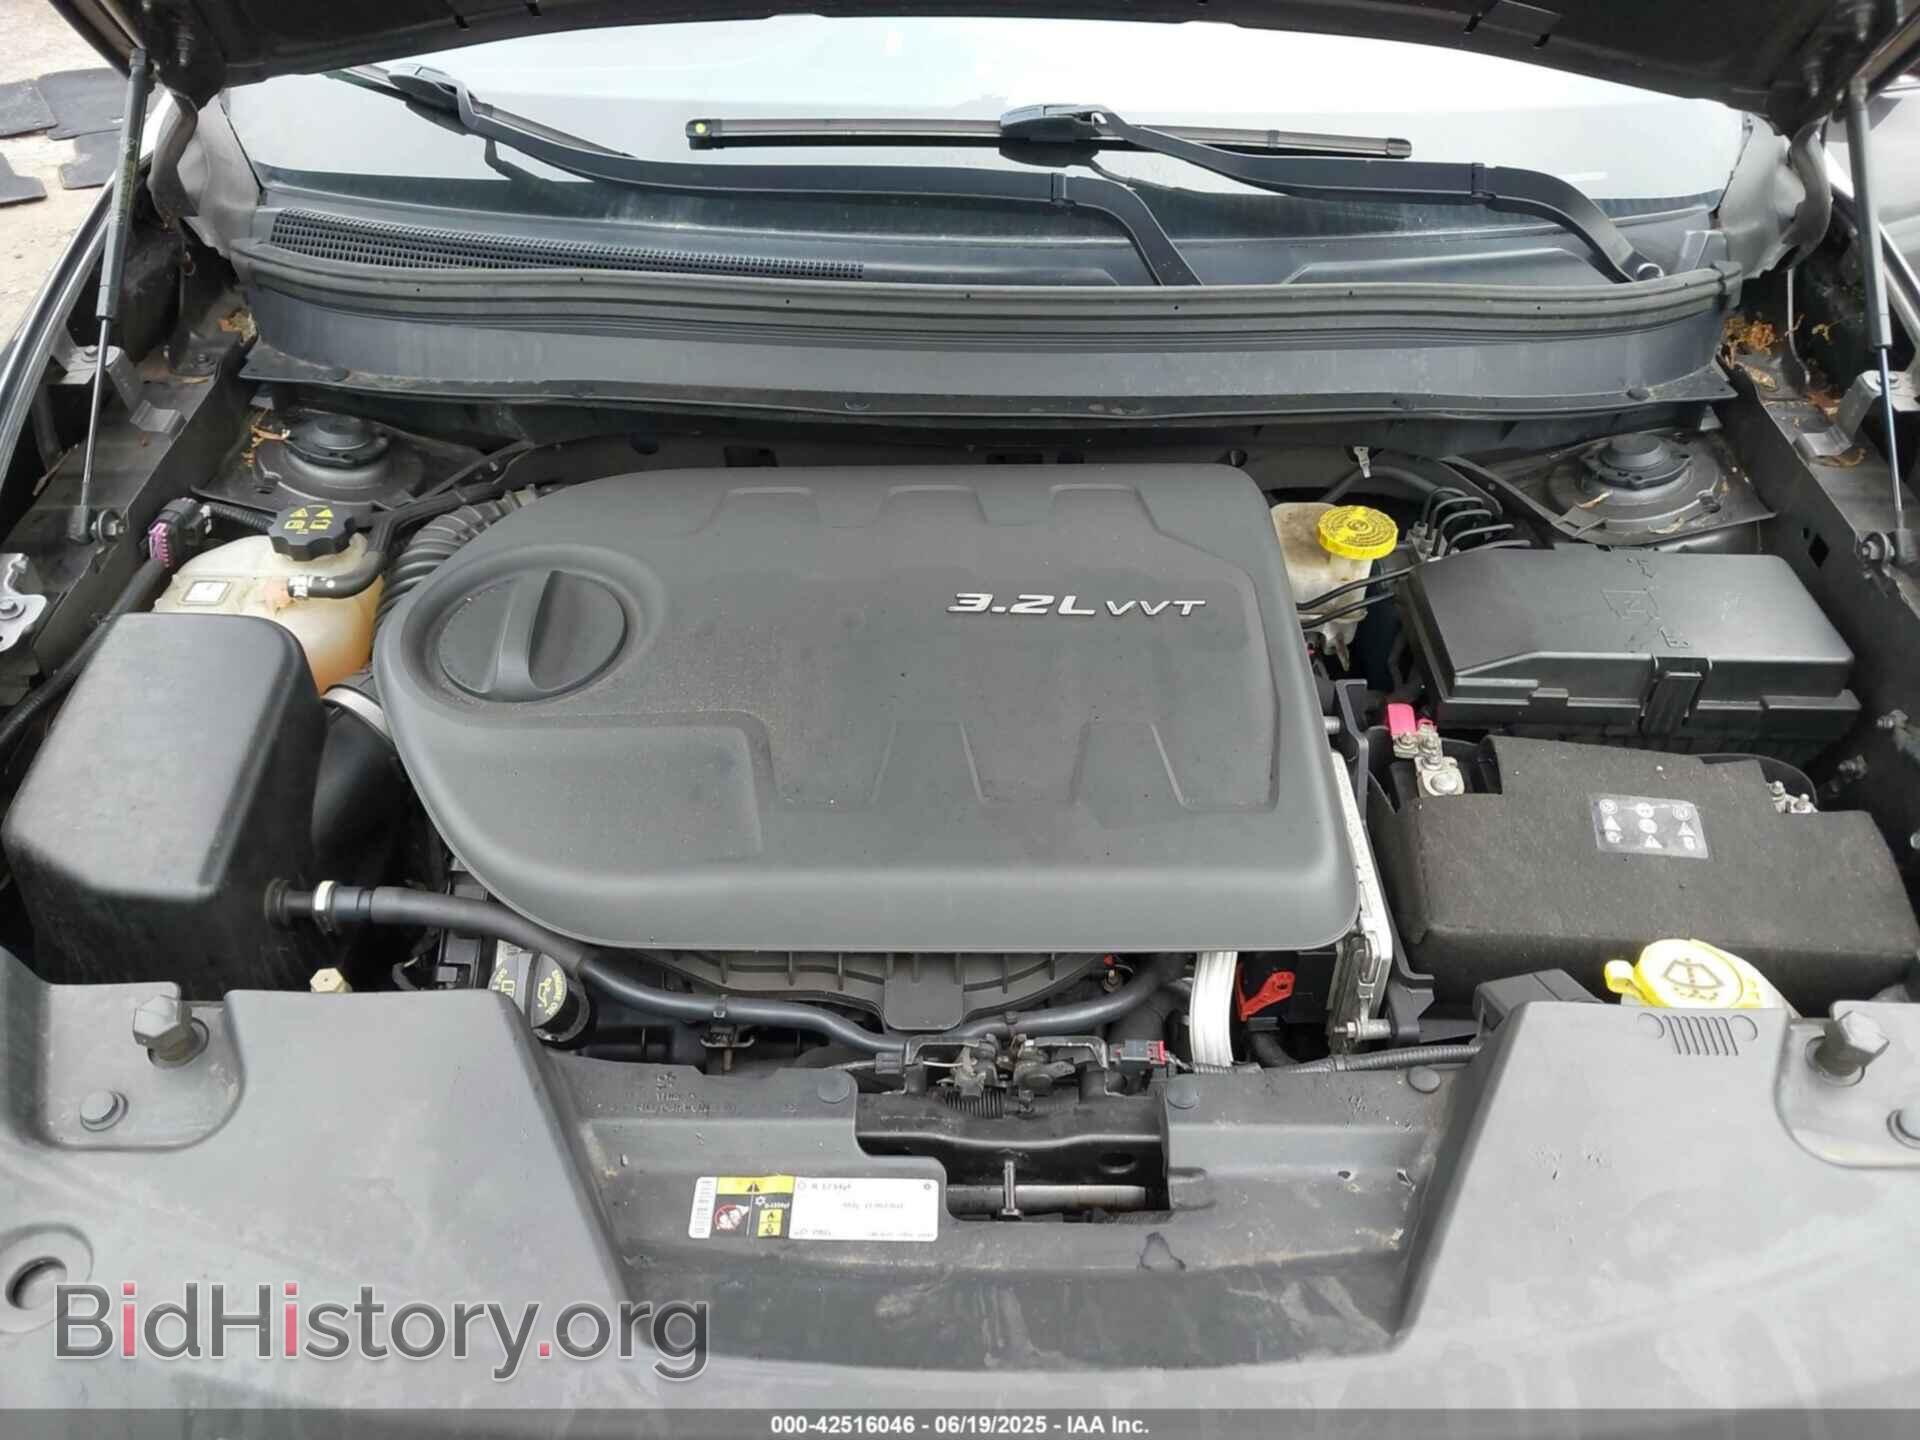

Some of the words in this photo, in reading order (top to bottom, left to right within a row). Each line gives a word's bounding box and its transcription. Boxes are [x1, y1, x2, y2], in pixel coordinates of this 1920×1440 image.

[947, 593, 1096, 615] 3.2L
[1105, 600, 1206, 616] VVT
[545, 1002, 559, 1016] OIL
